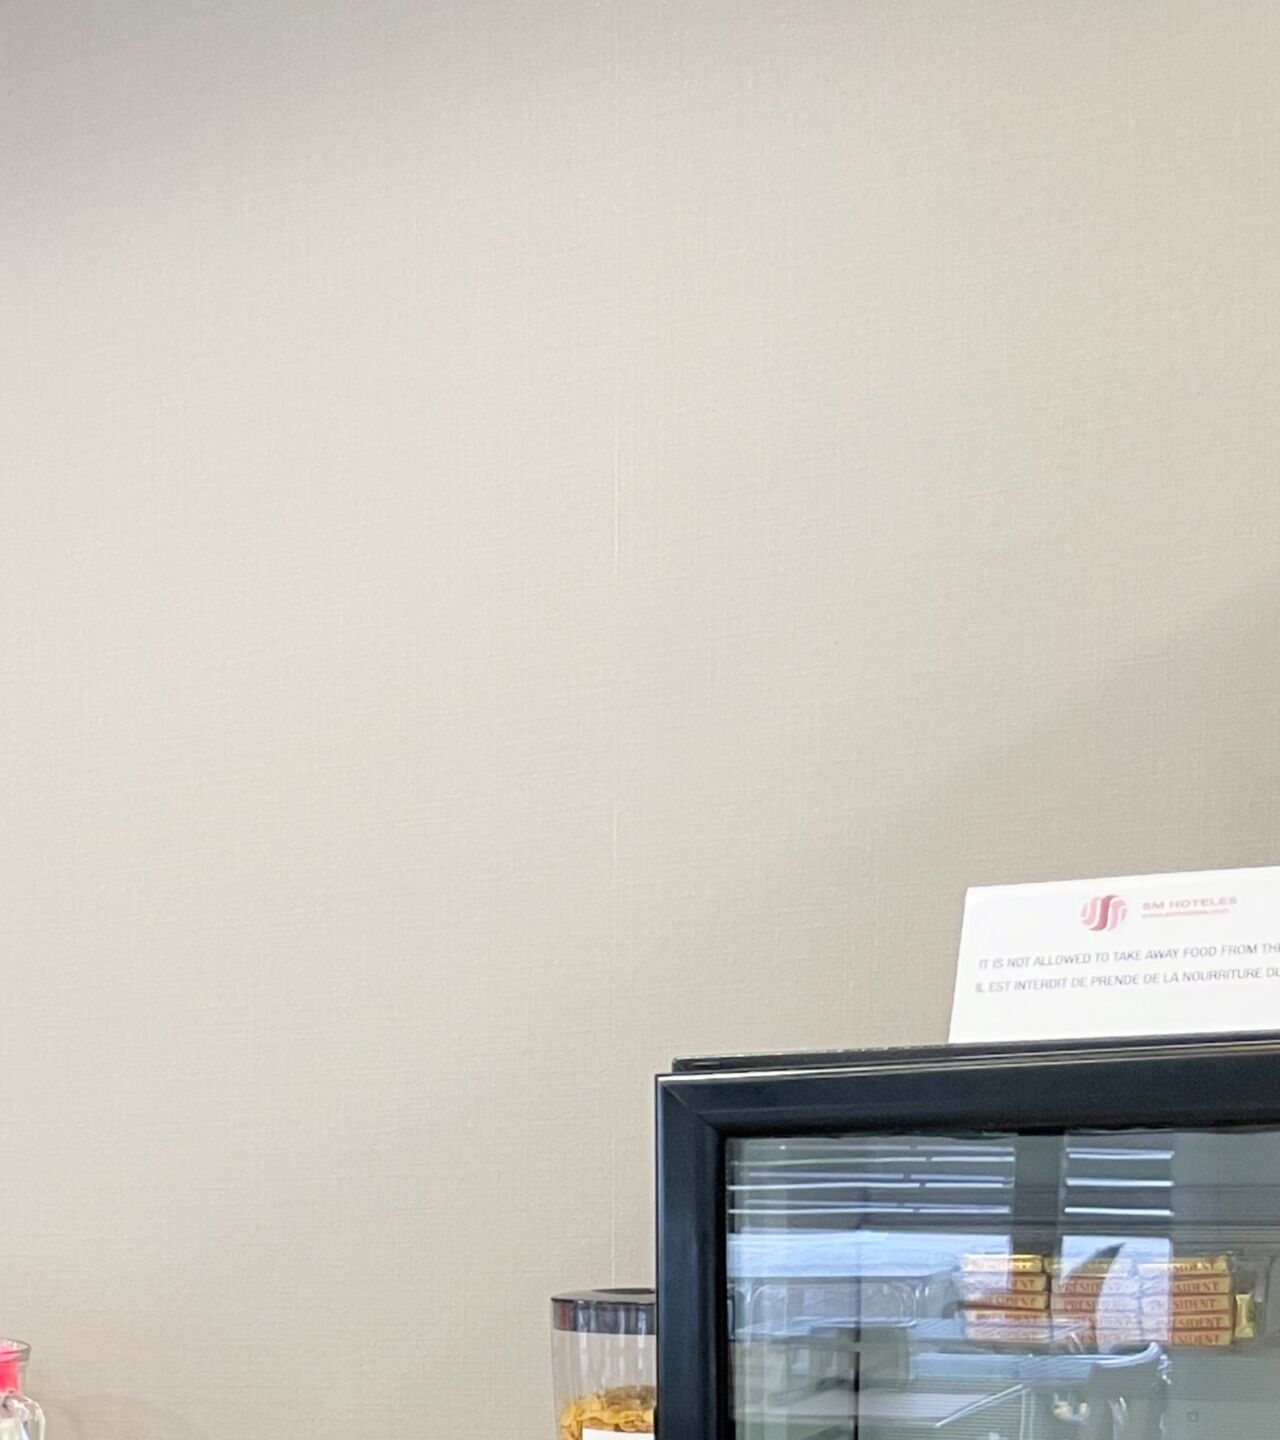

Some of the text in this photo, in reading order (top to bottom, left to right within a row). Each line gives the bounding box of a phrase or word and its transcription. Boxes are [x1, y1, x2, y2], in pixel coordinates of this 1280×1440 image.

[992, 957, 1004, 969] IS
[1006, 956, 1030, 968] NOT
[1032, 952, 1091, 967] ALLOWED
[1095, 951, 1110, 964] TO
[1113, 950, 1141, 962] TAKE
[1144, 947, 1181, 960] AWAY
[1183, 945, 1217, 958] FOOD
[1220, 943, 1258, 956] FROM
[987, 980, 1011, 993] EST
[1014, 977, 1068, 991] INTERDIT
[1071, 976, 1088, 988] DE
[1090, 974, 1139, 987] PRENDE
[1143, 973, 1160, 985] DE
[1163, 971, 1179, 984] LA
[1182, 966, 1262, 982] NOURRITURE
